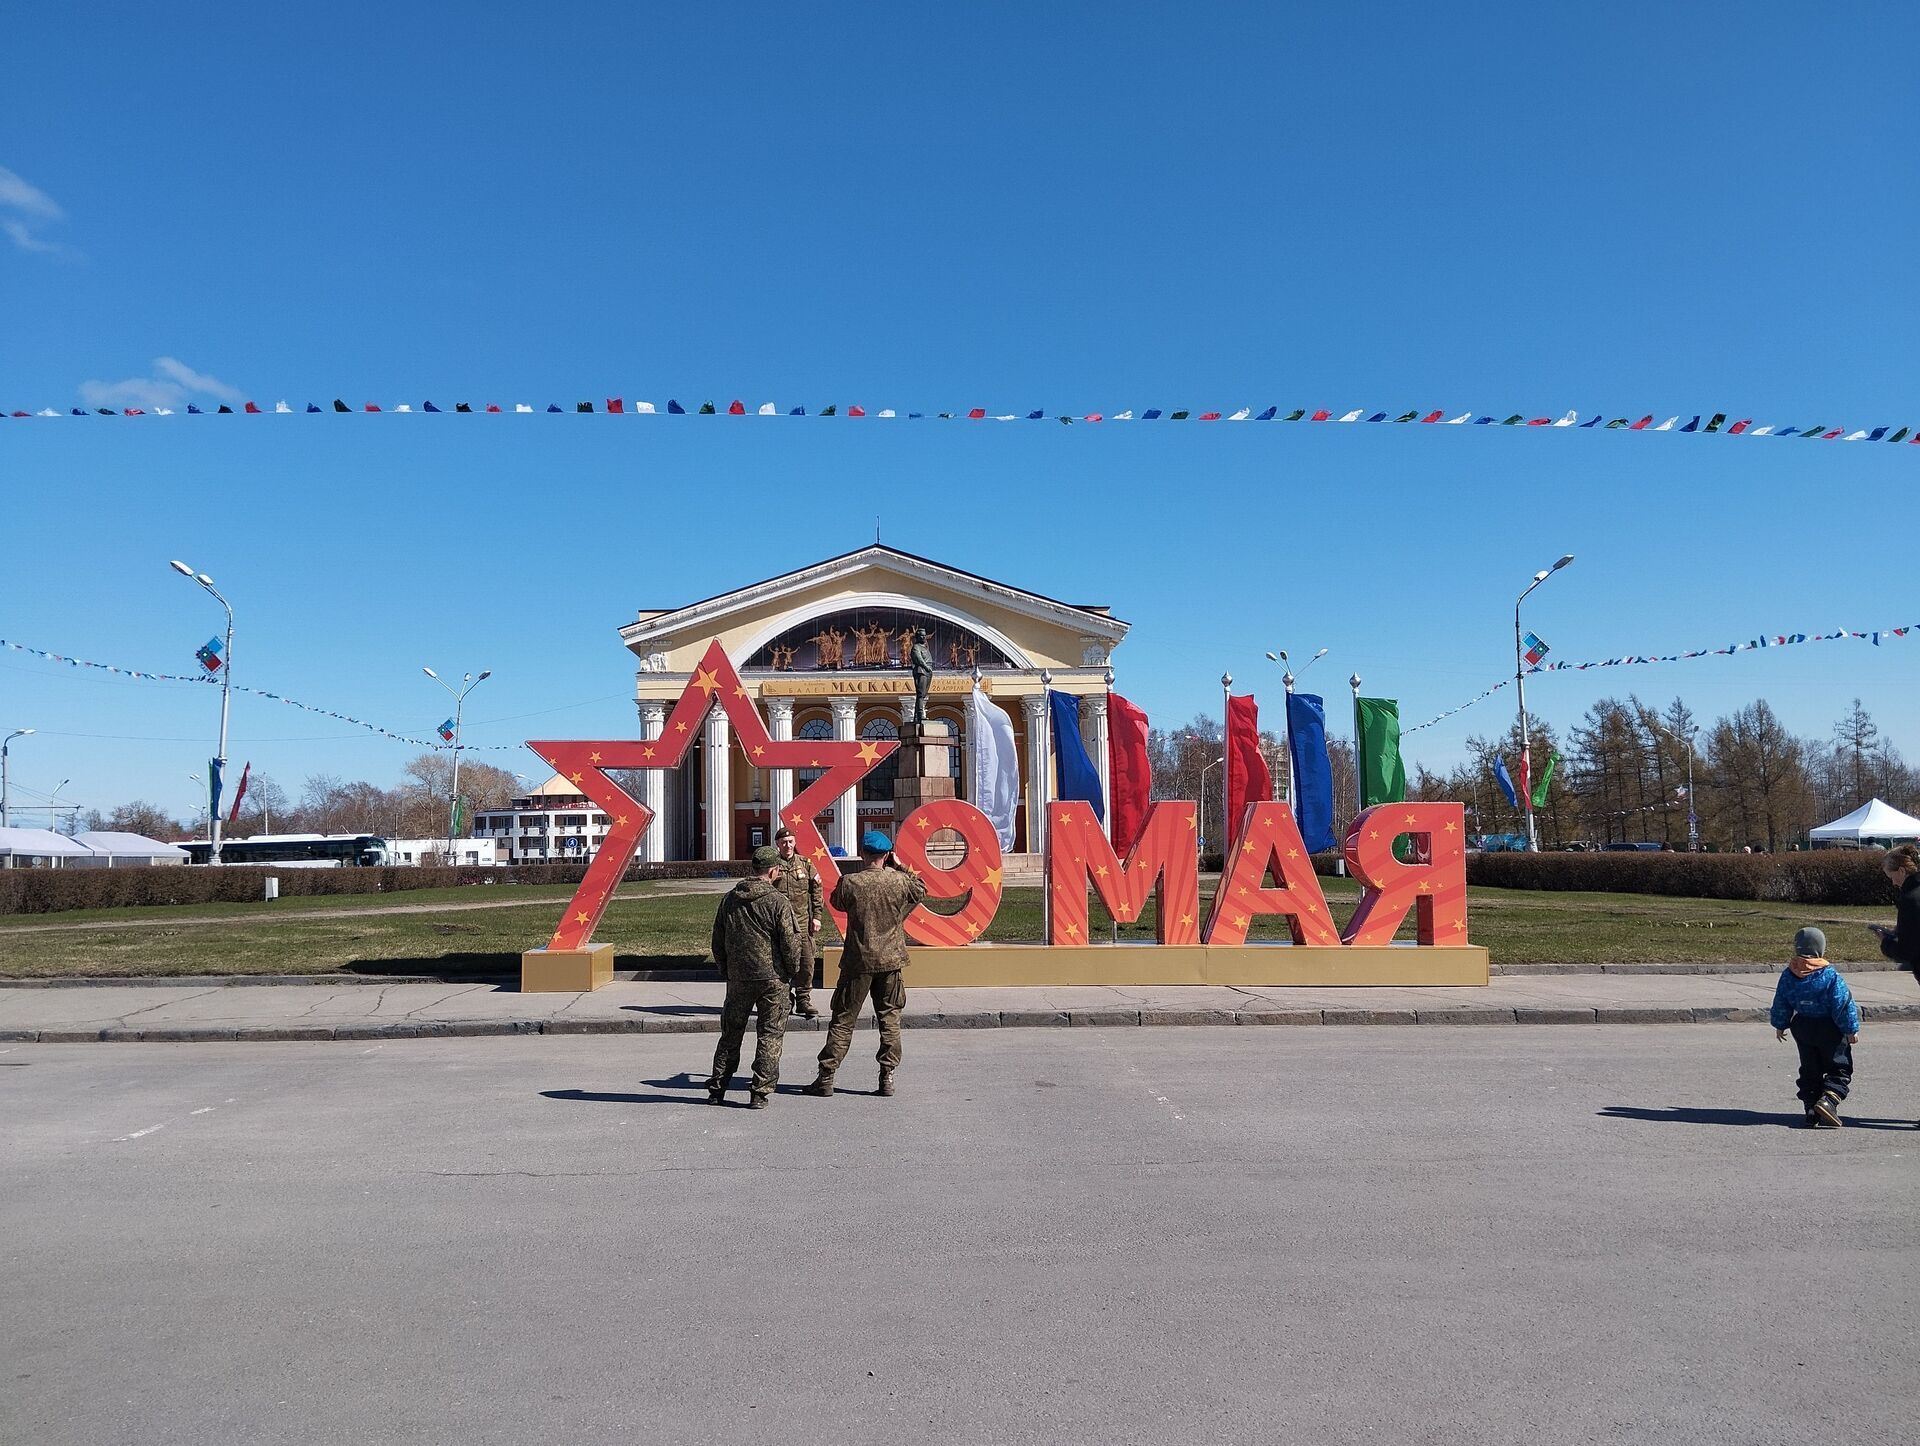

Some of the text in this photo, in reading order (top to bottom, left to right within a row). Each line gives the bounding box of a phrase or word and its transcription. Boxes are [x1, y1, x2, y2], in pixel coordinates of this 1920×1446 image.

[831, 681, 914, 693] МАСКАРА
[895, 799, 1468, 948] 9 МАЯ
